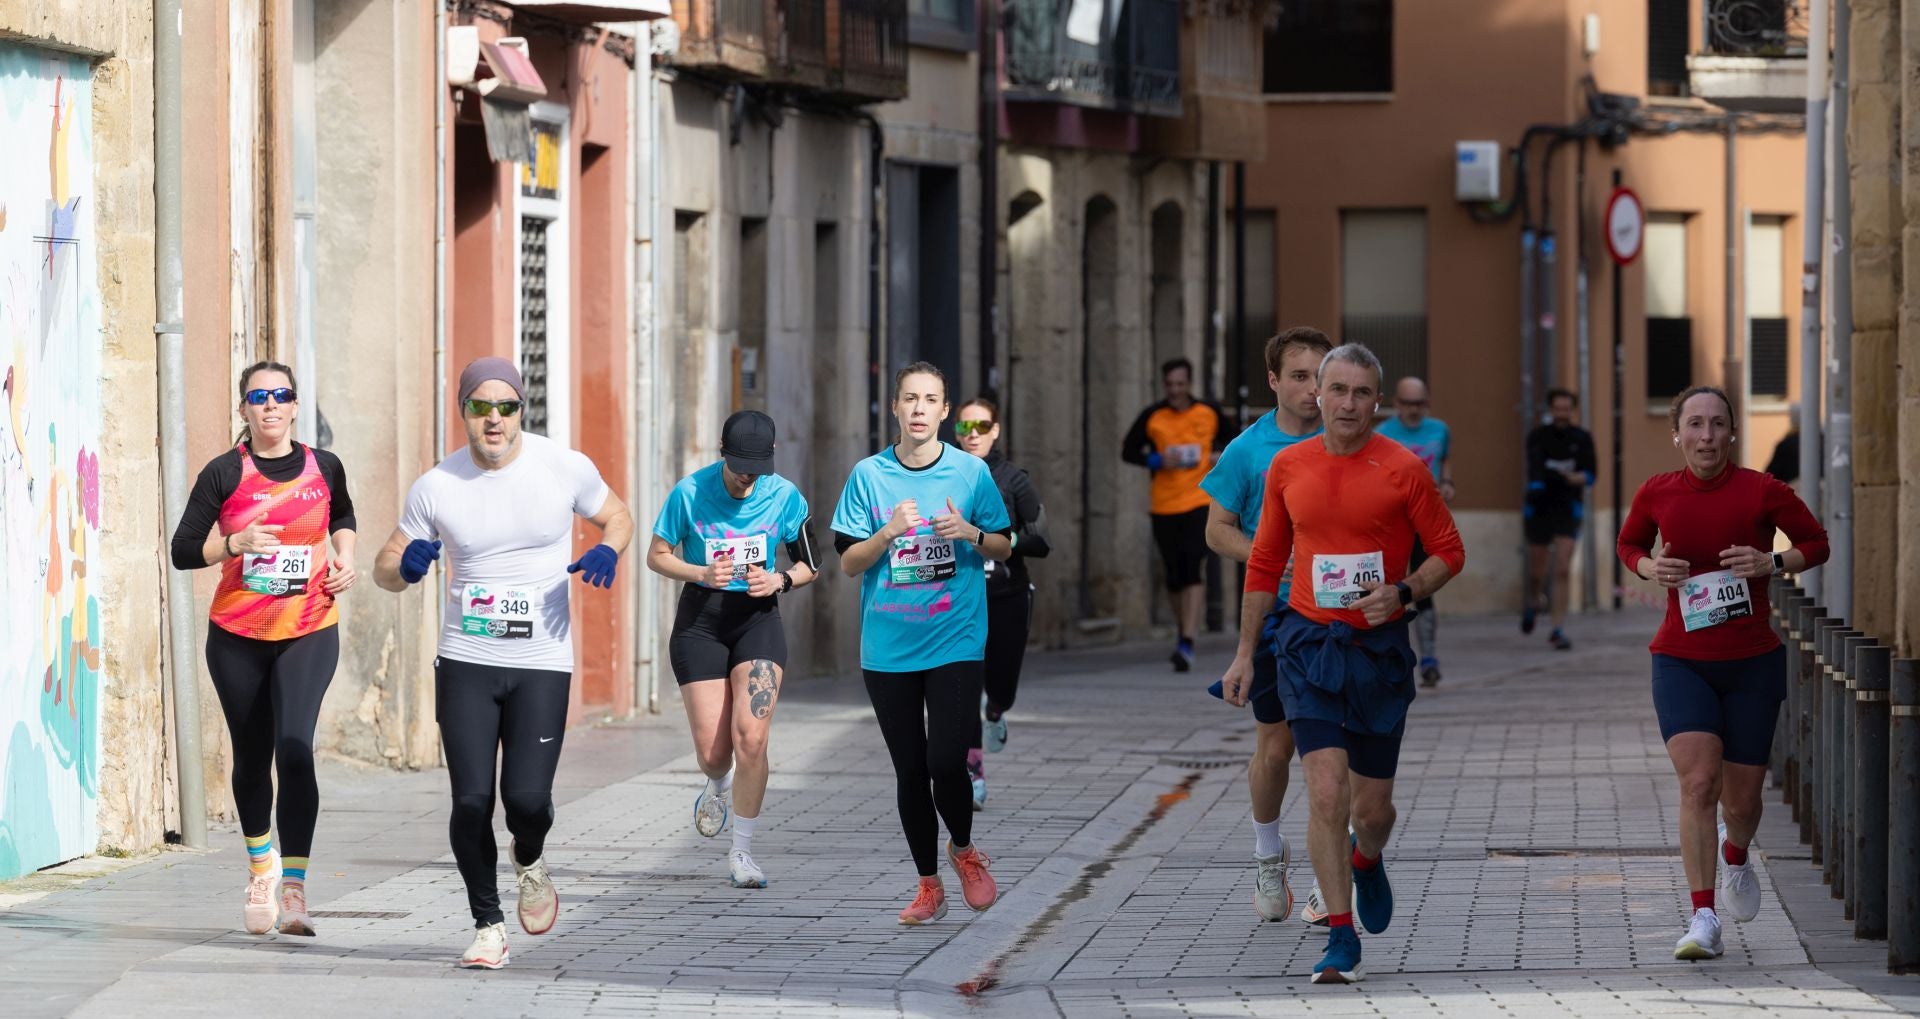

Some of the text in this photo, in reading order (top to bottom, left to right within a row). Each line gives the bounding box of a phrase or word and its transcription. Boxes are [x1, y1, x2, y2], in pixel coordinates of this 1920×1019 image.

[744, 547, 759, 559] 79
[925, 544, 951, 560] 203
[282, 559, 305, 573] 261
[1353, 570, 1380, 587] 405
[1717, 583, 1745, 602] 404
[500, 600, 529, 615] 349
[875, 601, 926, 614] LABORAL
